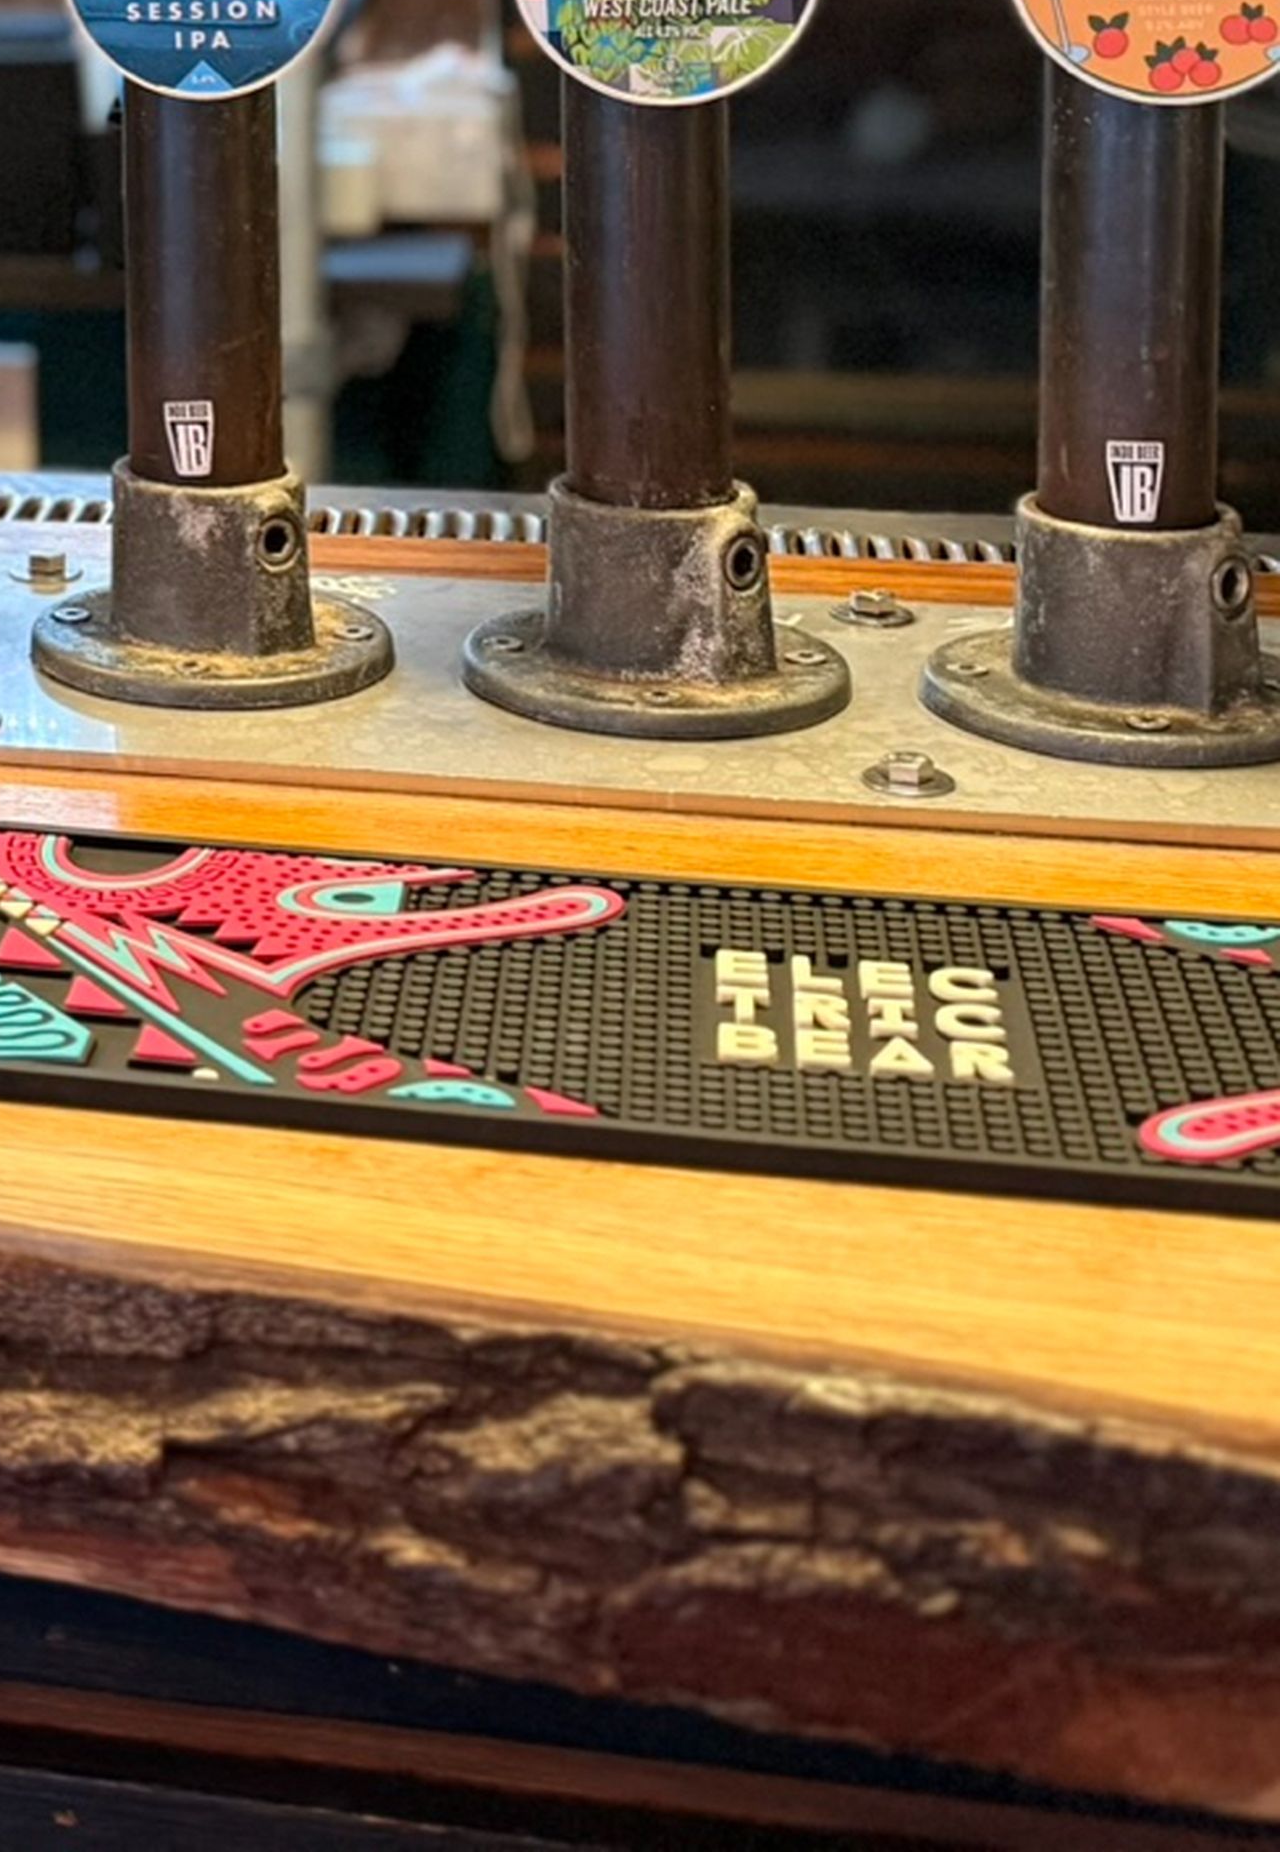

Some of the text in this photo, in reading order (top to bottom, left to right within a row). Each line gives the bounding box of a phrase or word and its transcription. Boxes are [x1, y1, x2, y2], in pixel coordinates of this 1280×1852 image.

[126, 0, 278, 21] SESSION
[174, 29, 231, 50] IPA
[716, 949, 999, 1008] ELEC
[716, 984, 1008, 1043] TRIC
[717, 1020, 1016, 1084] BEAR
